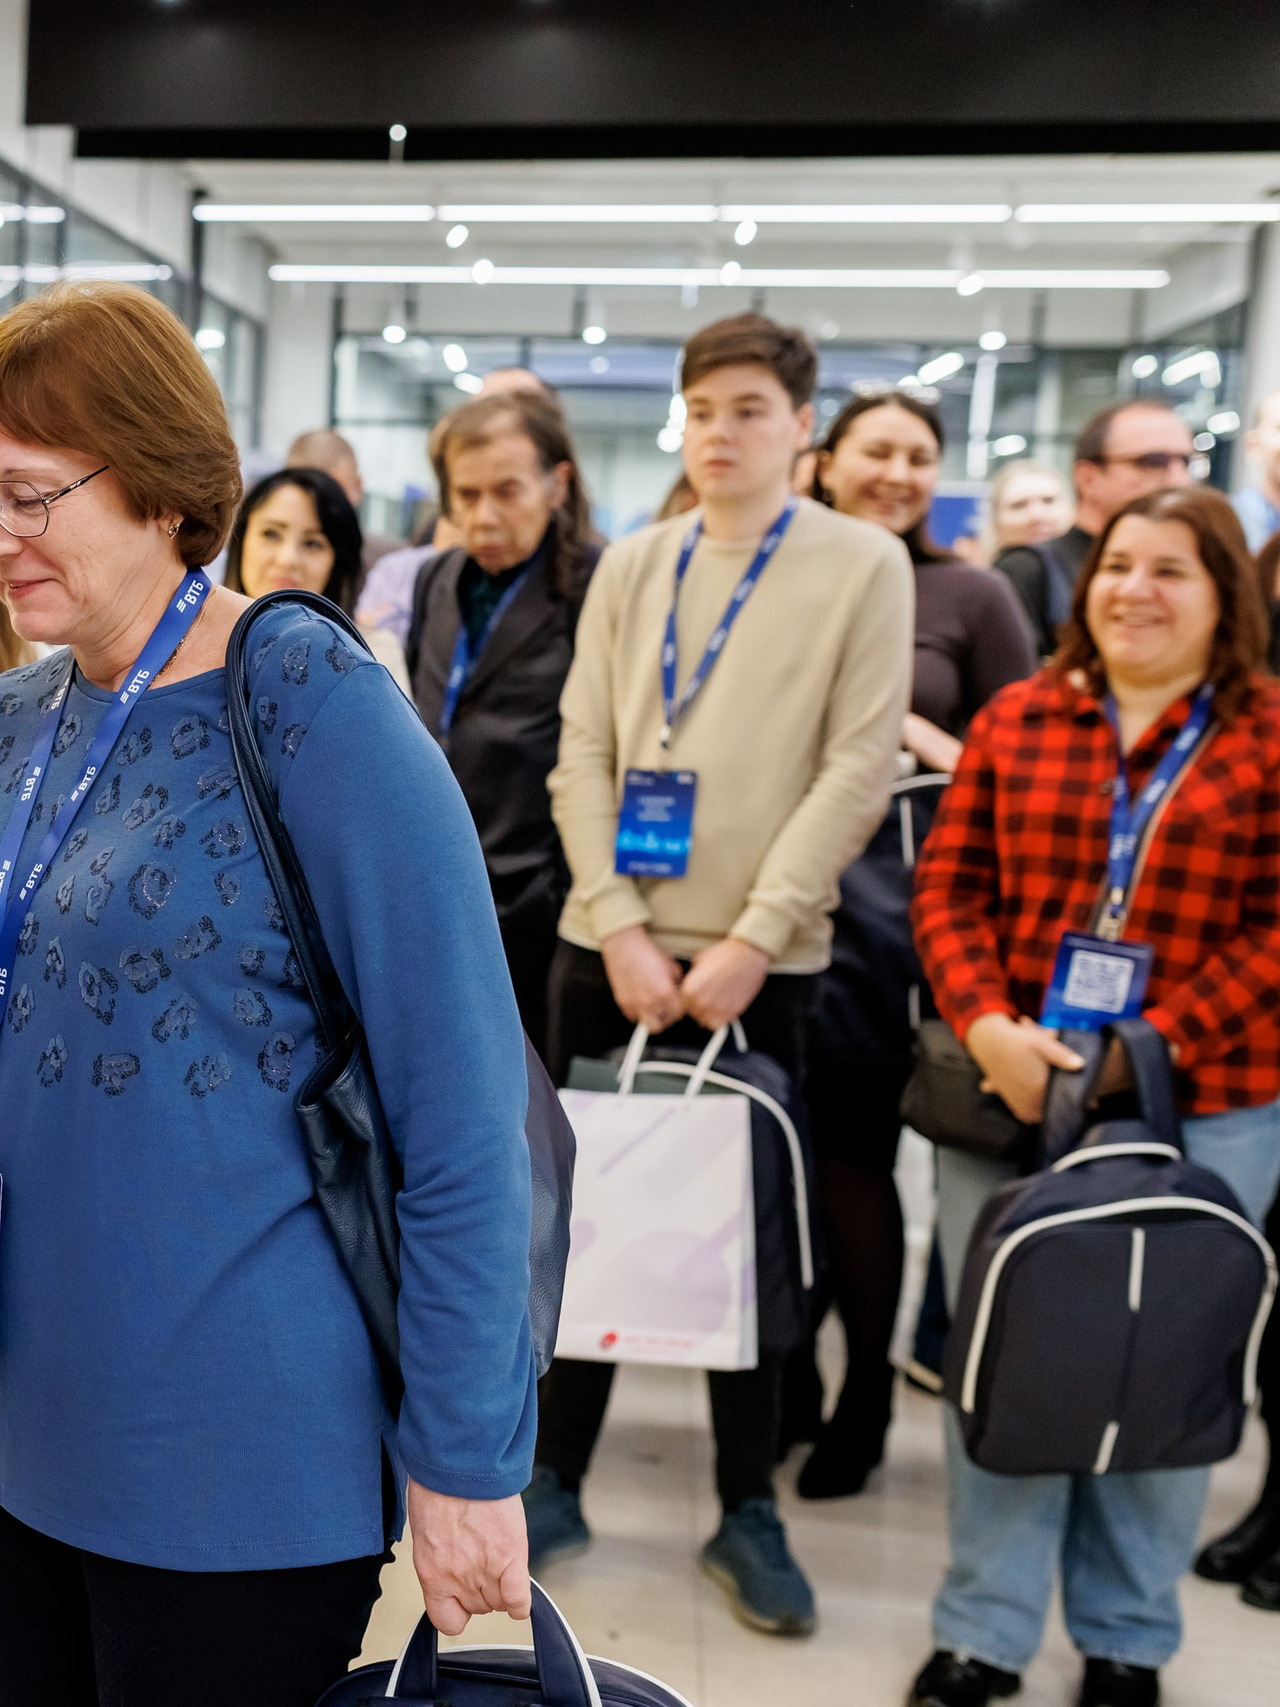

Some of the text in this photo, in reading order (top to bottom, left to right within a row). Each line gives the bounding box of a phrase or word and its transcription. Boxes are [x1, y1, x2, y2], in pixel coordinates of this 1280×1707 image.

[184, 579, 204, 605] ВТБ
[127, 669, 150, 694] ВТБ
[21, 777, 36, 801] ВТБ
[78, 765, 96, 791] ВТБ
[26, 862, 43, 890] ВТБ
